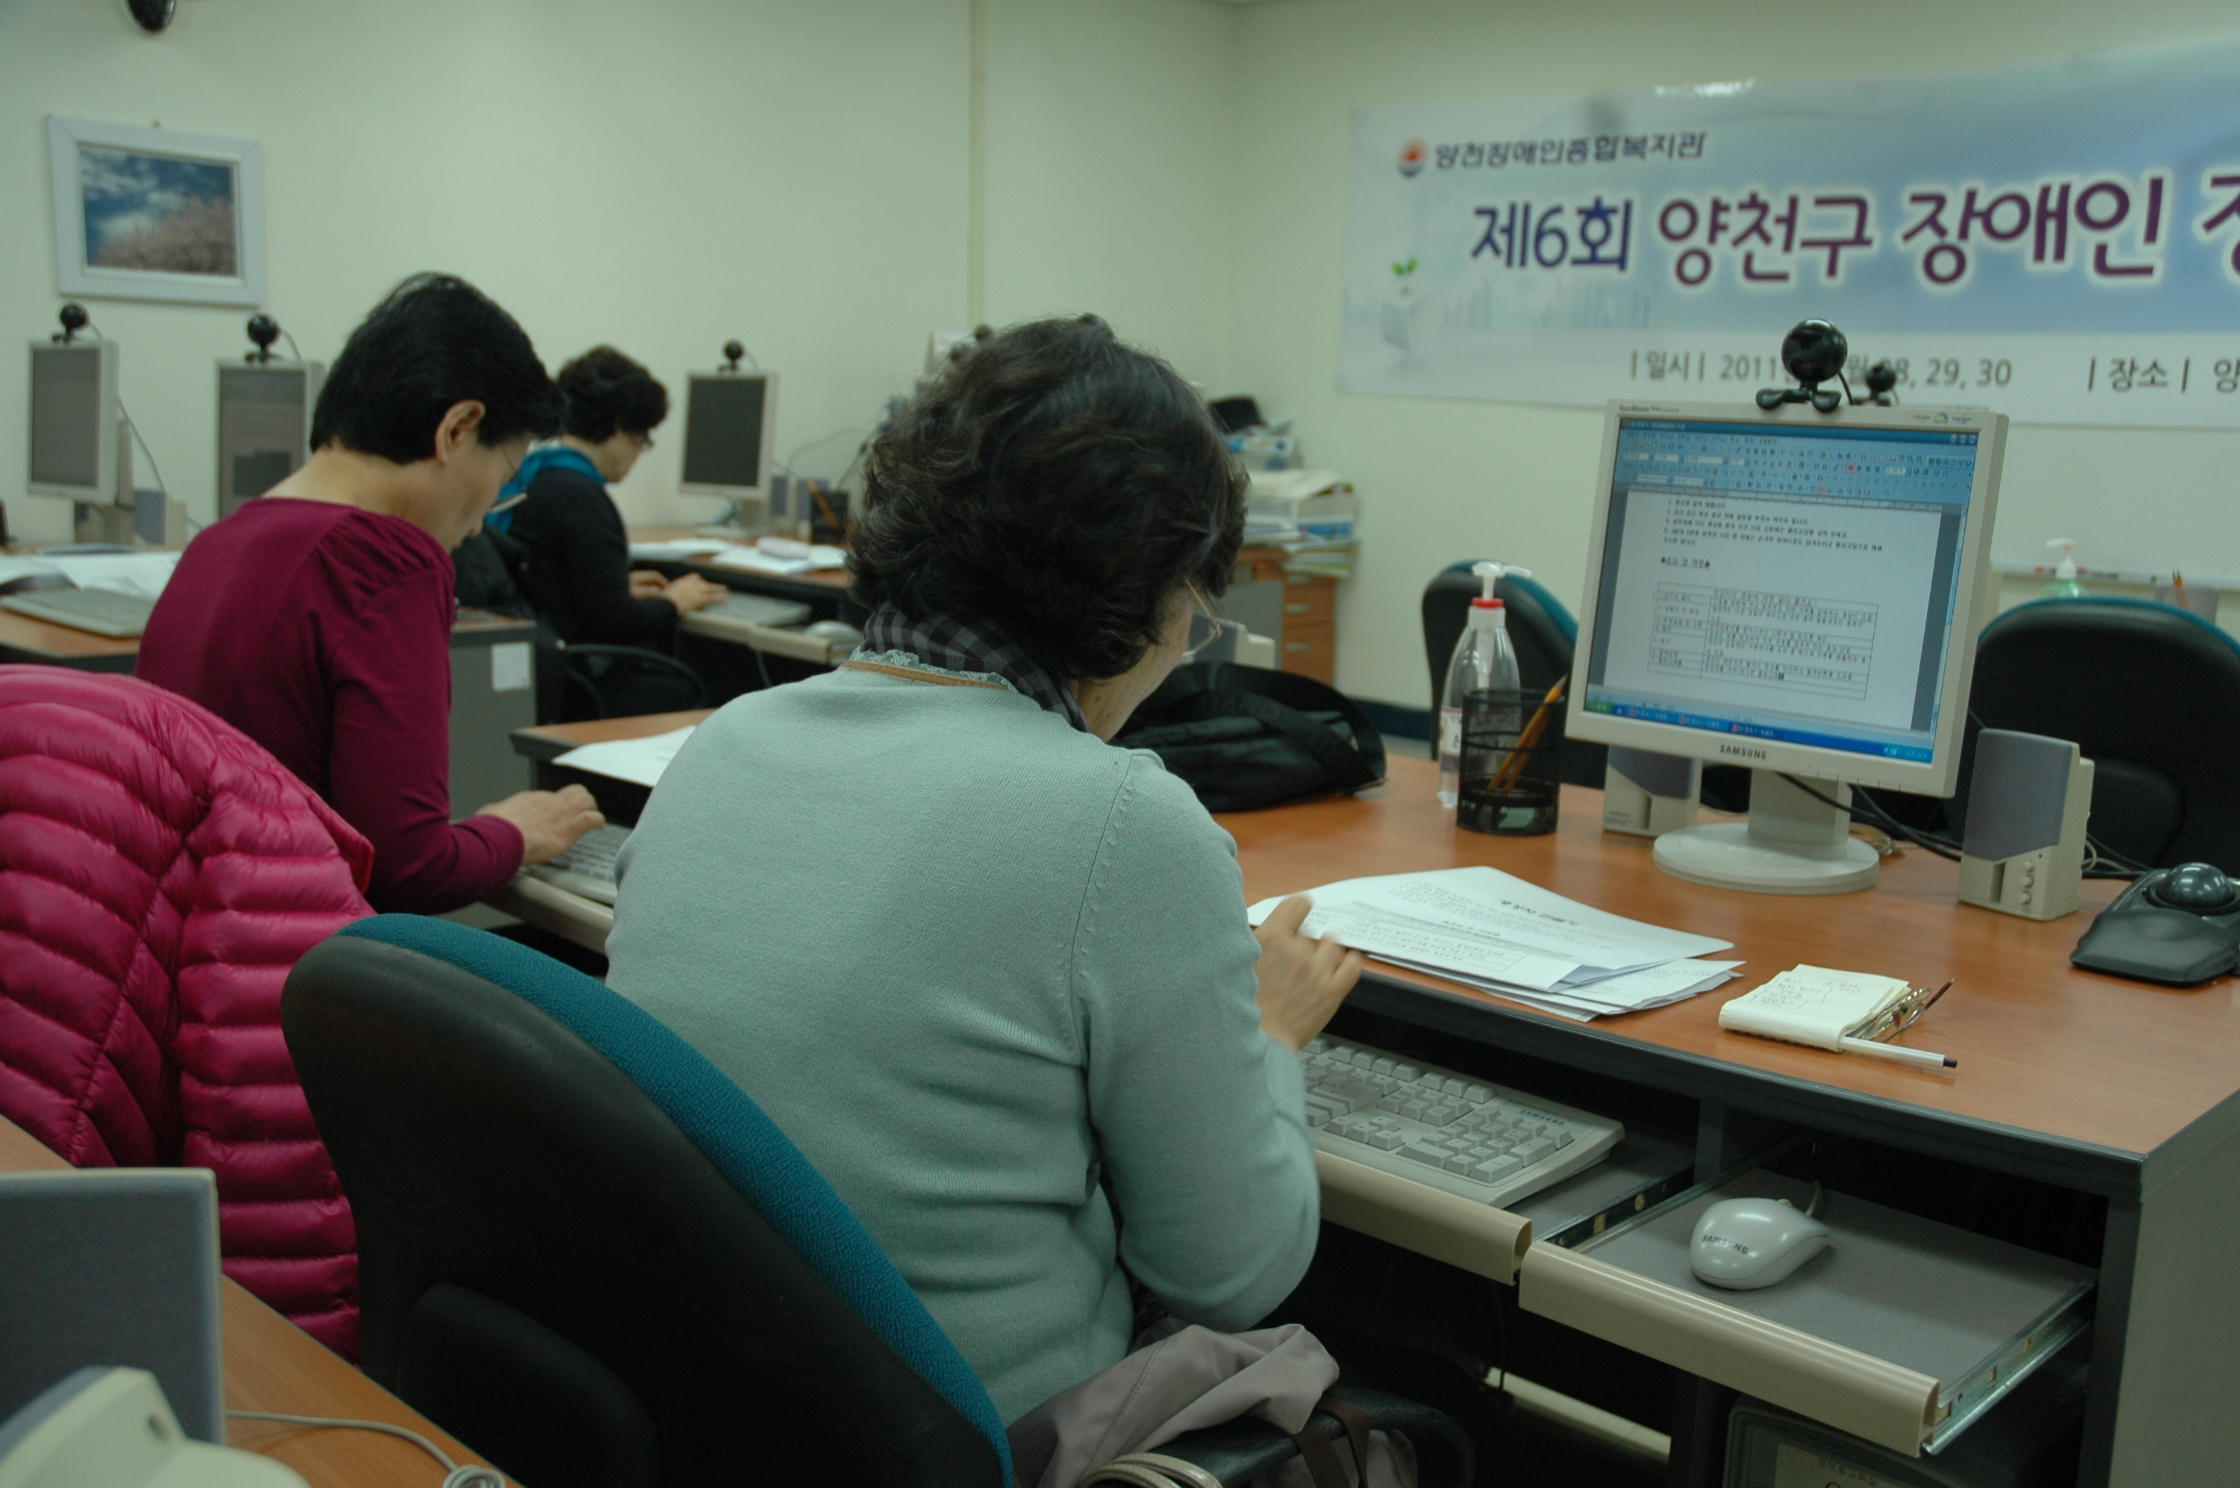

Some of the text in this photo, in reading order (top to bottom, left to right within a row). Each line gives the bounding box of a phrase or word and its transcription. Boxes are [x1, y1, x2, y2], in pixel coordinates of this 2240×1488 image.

[1436, 132, 1707, 169] 양천장애인종합복지관
[1472, 197, 1633, 272] 제6회
[1658, 191, 1874, 286] 양천구
[1901, 177, 2163, 285] 장애인
[1926, 357, 1966, 390] 29,
[1976, 357, 2012, 386] 30
[1720, 744, 1768, 760] SAMSUNG
[1701, 1234, 1749, 1254] SAMSUNG
